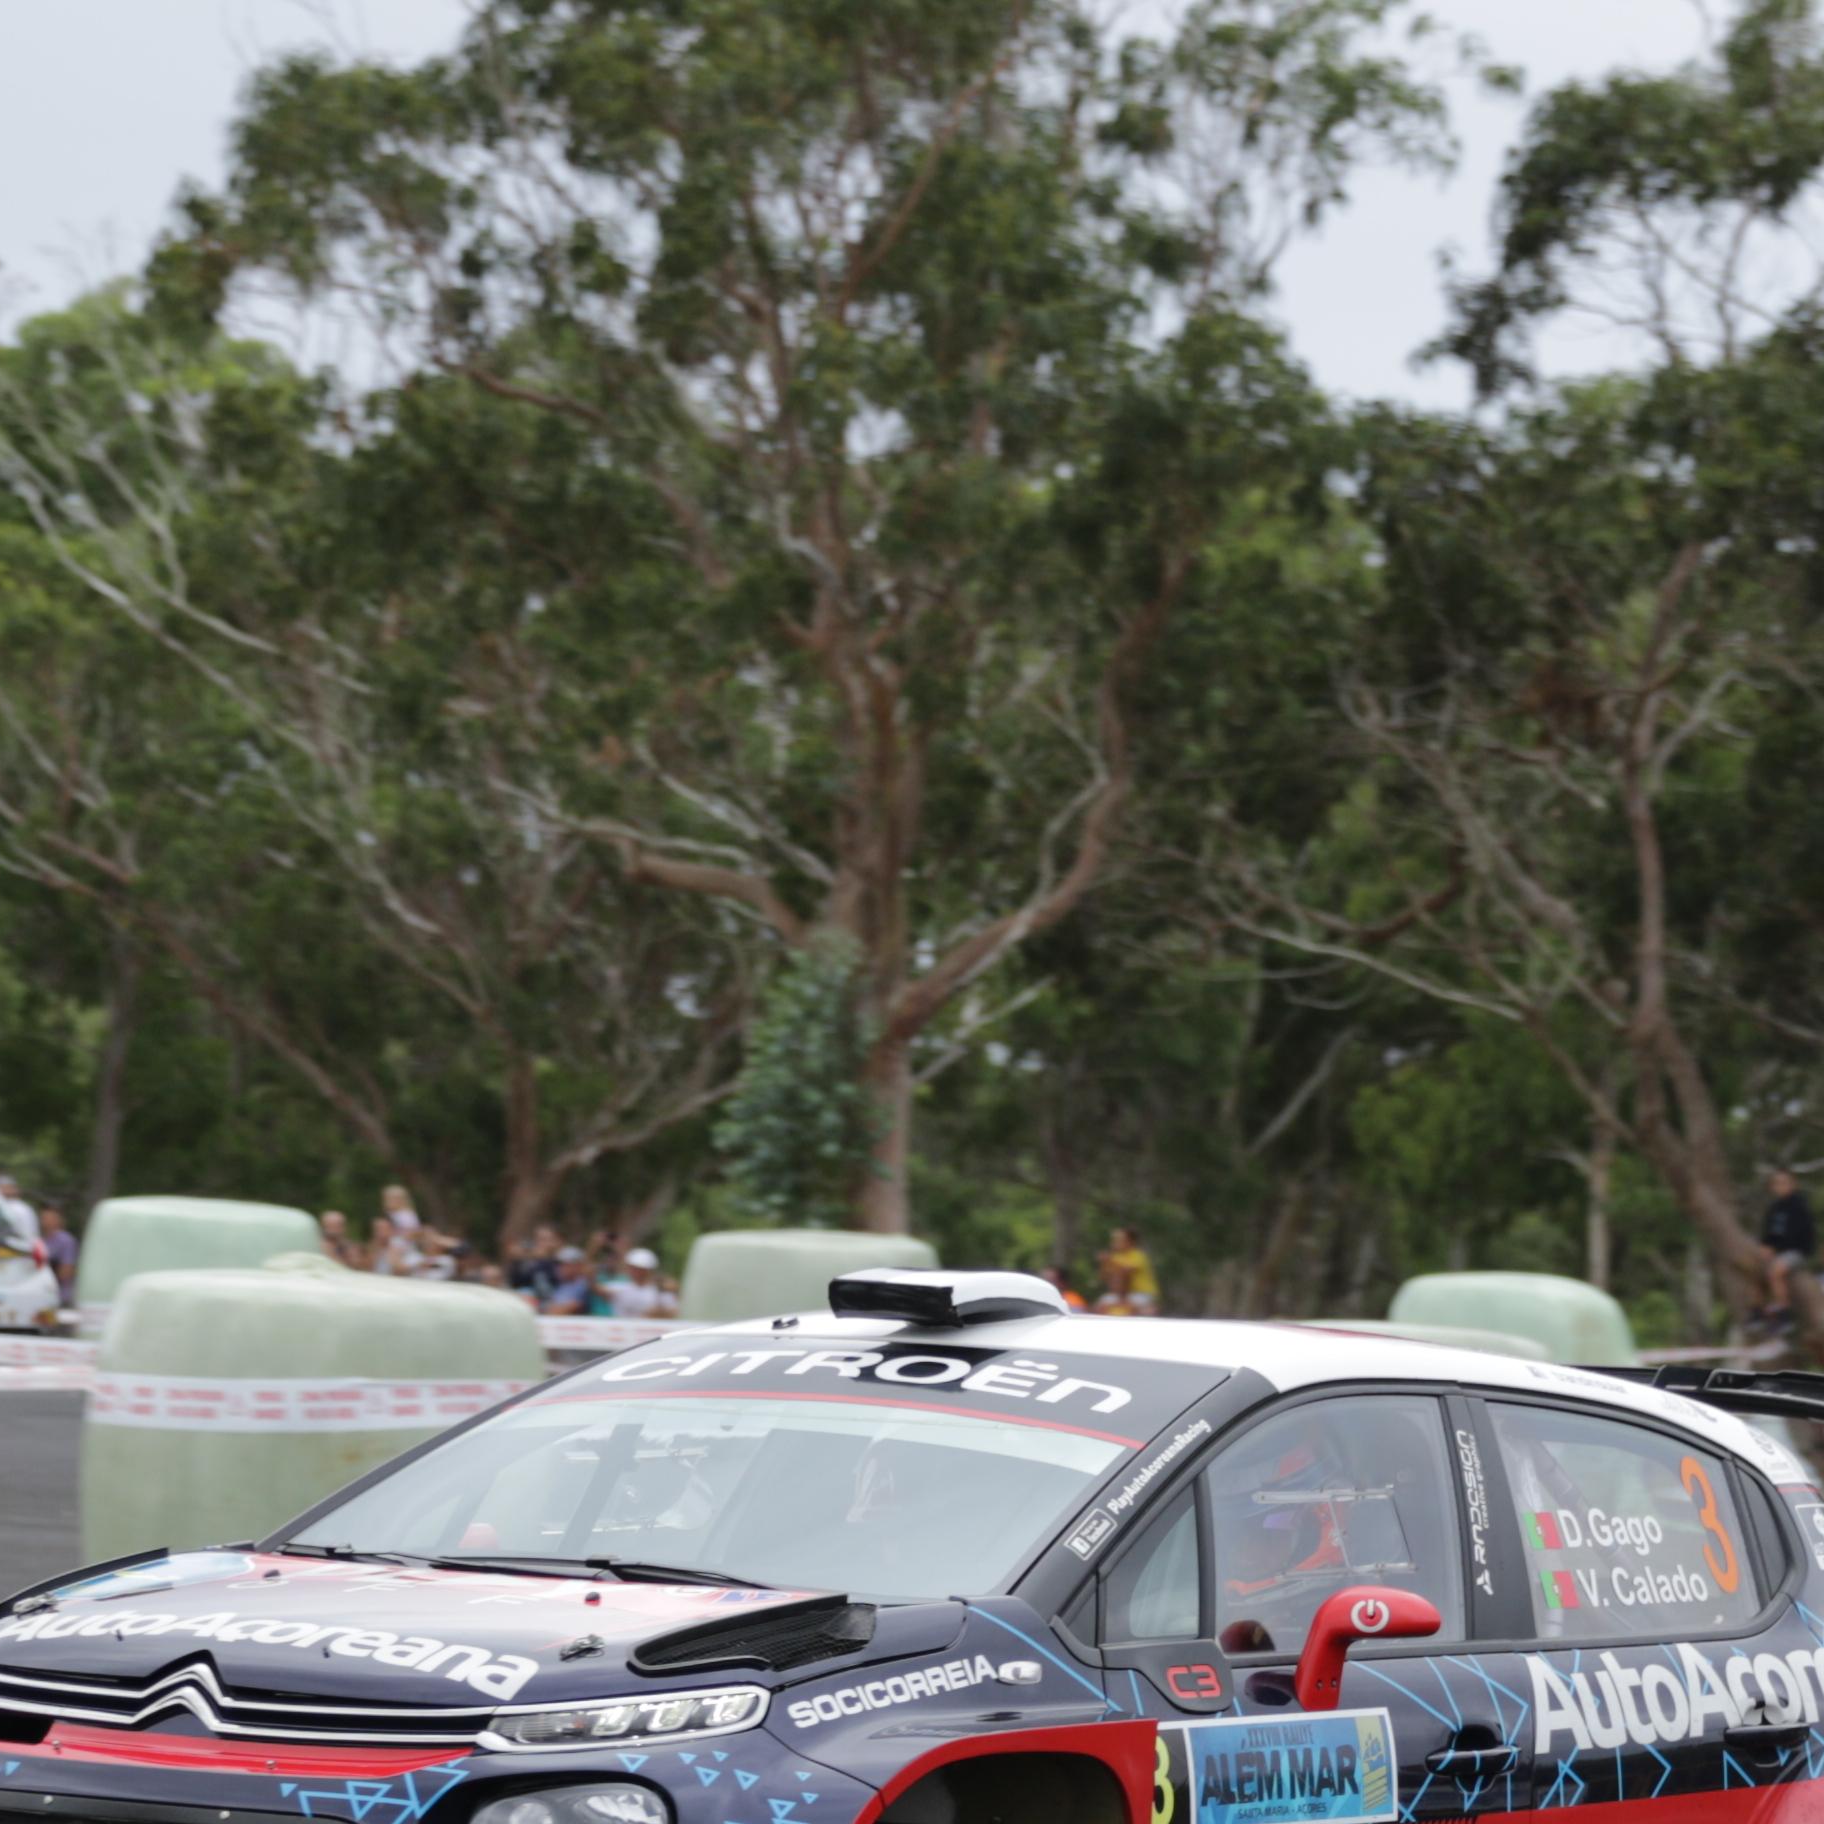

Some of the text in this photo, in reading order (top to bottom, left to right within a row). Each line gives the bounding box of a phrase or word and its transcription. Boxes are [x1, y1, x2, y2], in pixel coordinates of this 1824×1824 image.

[601, 1349, 1133, 1414] CITROËN
[1680, 1456, 1740, 1594] 3
[1576, 1564, 1709, 1608] V. Calado
[787, 1654, 998, 1729] SOCICORREIA
[1167, 1664, 1222, 1699] C3
[1287, 1744, 1359, 1799] MAR
